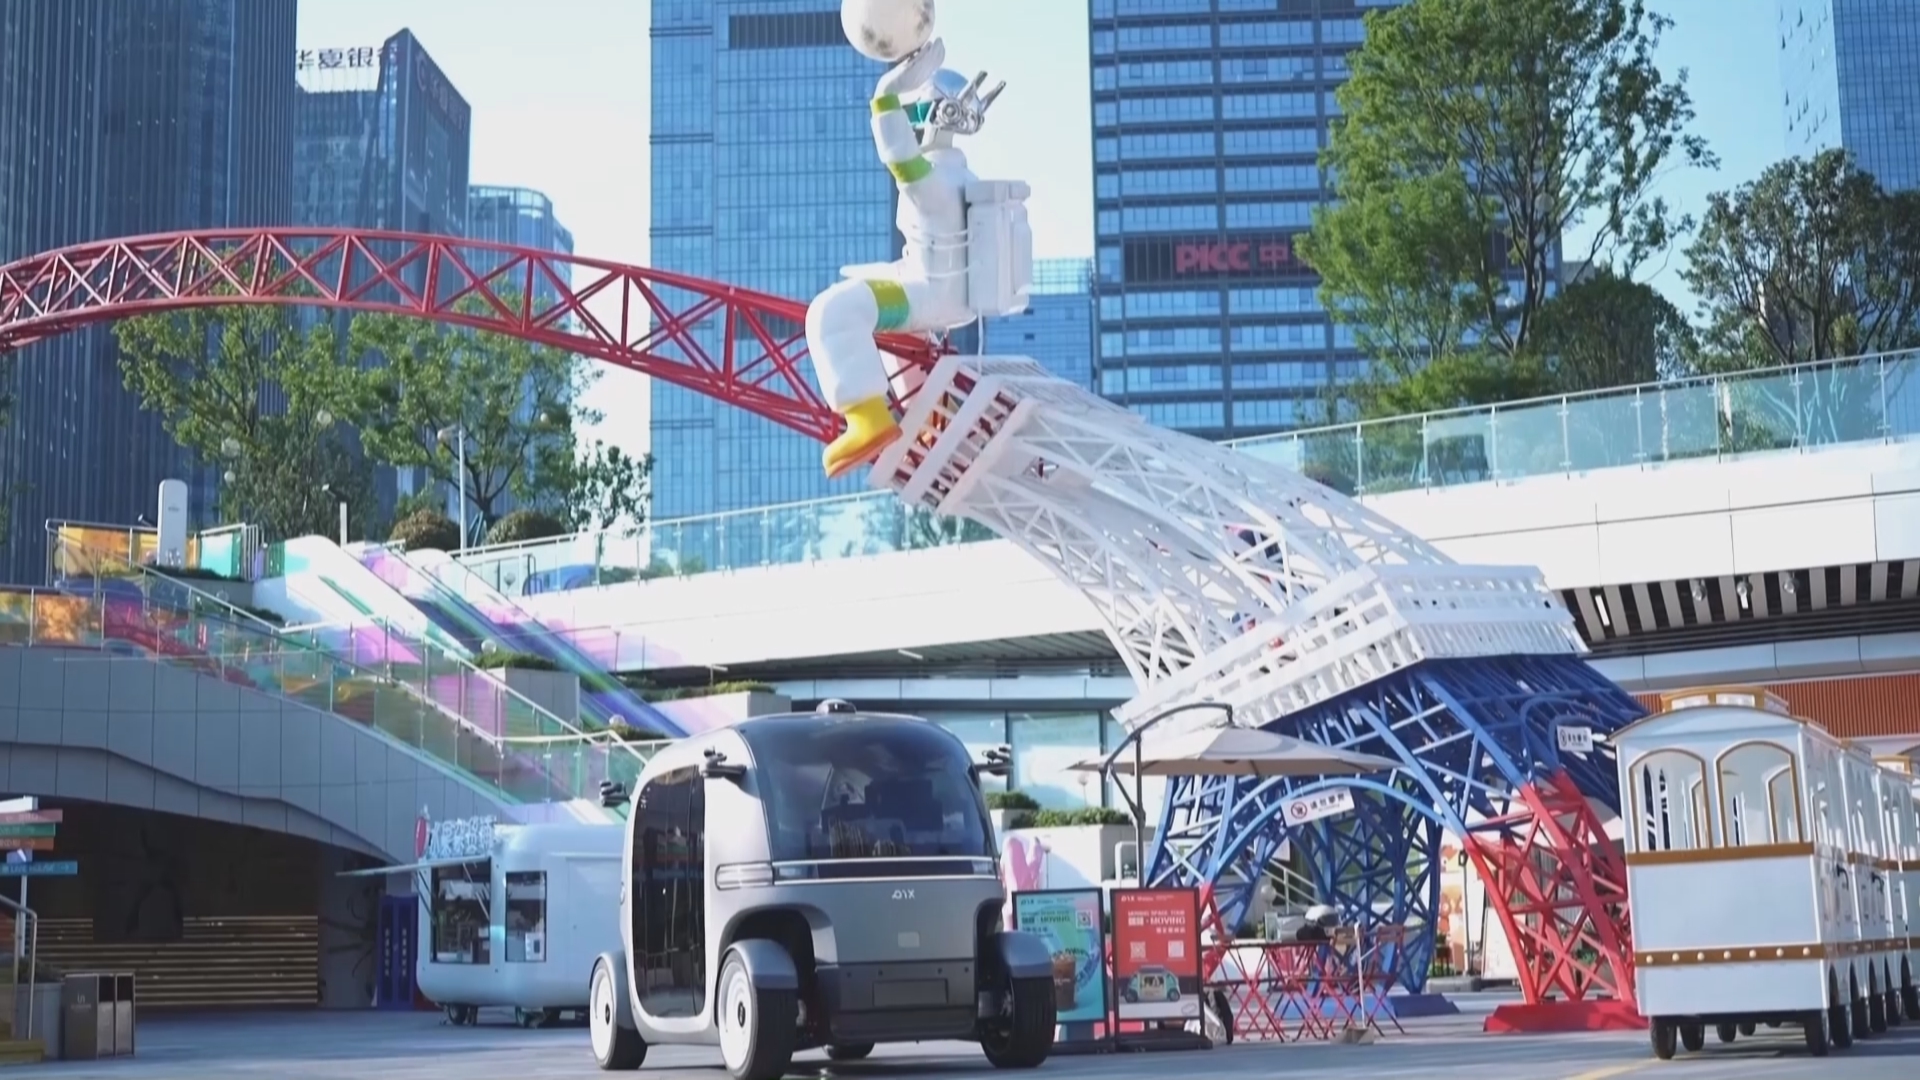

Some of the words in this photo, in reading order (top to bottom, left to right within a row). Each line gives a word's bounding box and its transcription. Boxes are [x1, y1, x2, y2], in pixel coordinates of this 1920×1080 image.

[296, 46, 384, 70] 华夏银
[1175, 244, 1249, 273] PICC
[1150, 916, 1186, 925] MOVING
